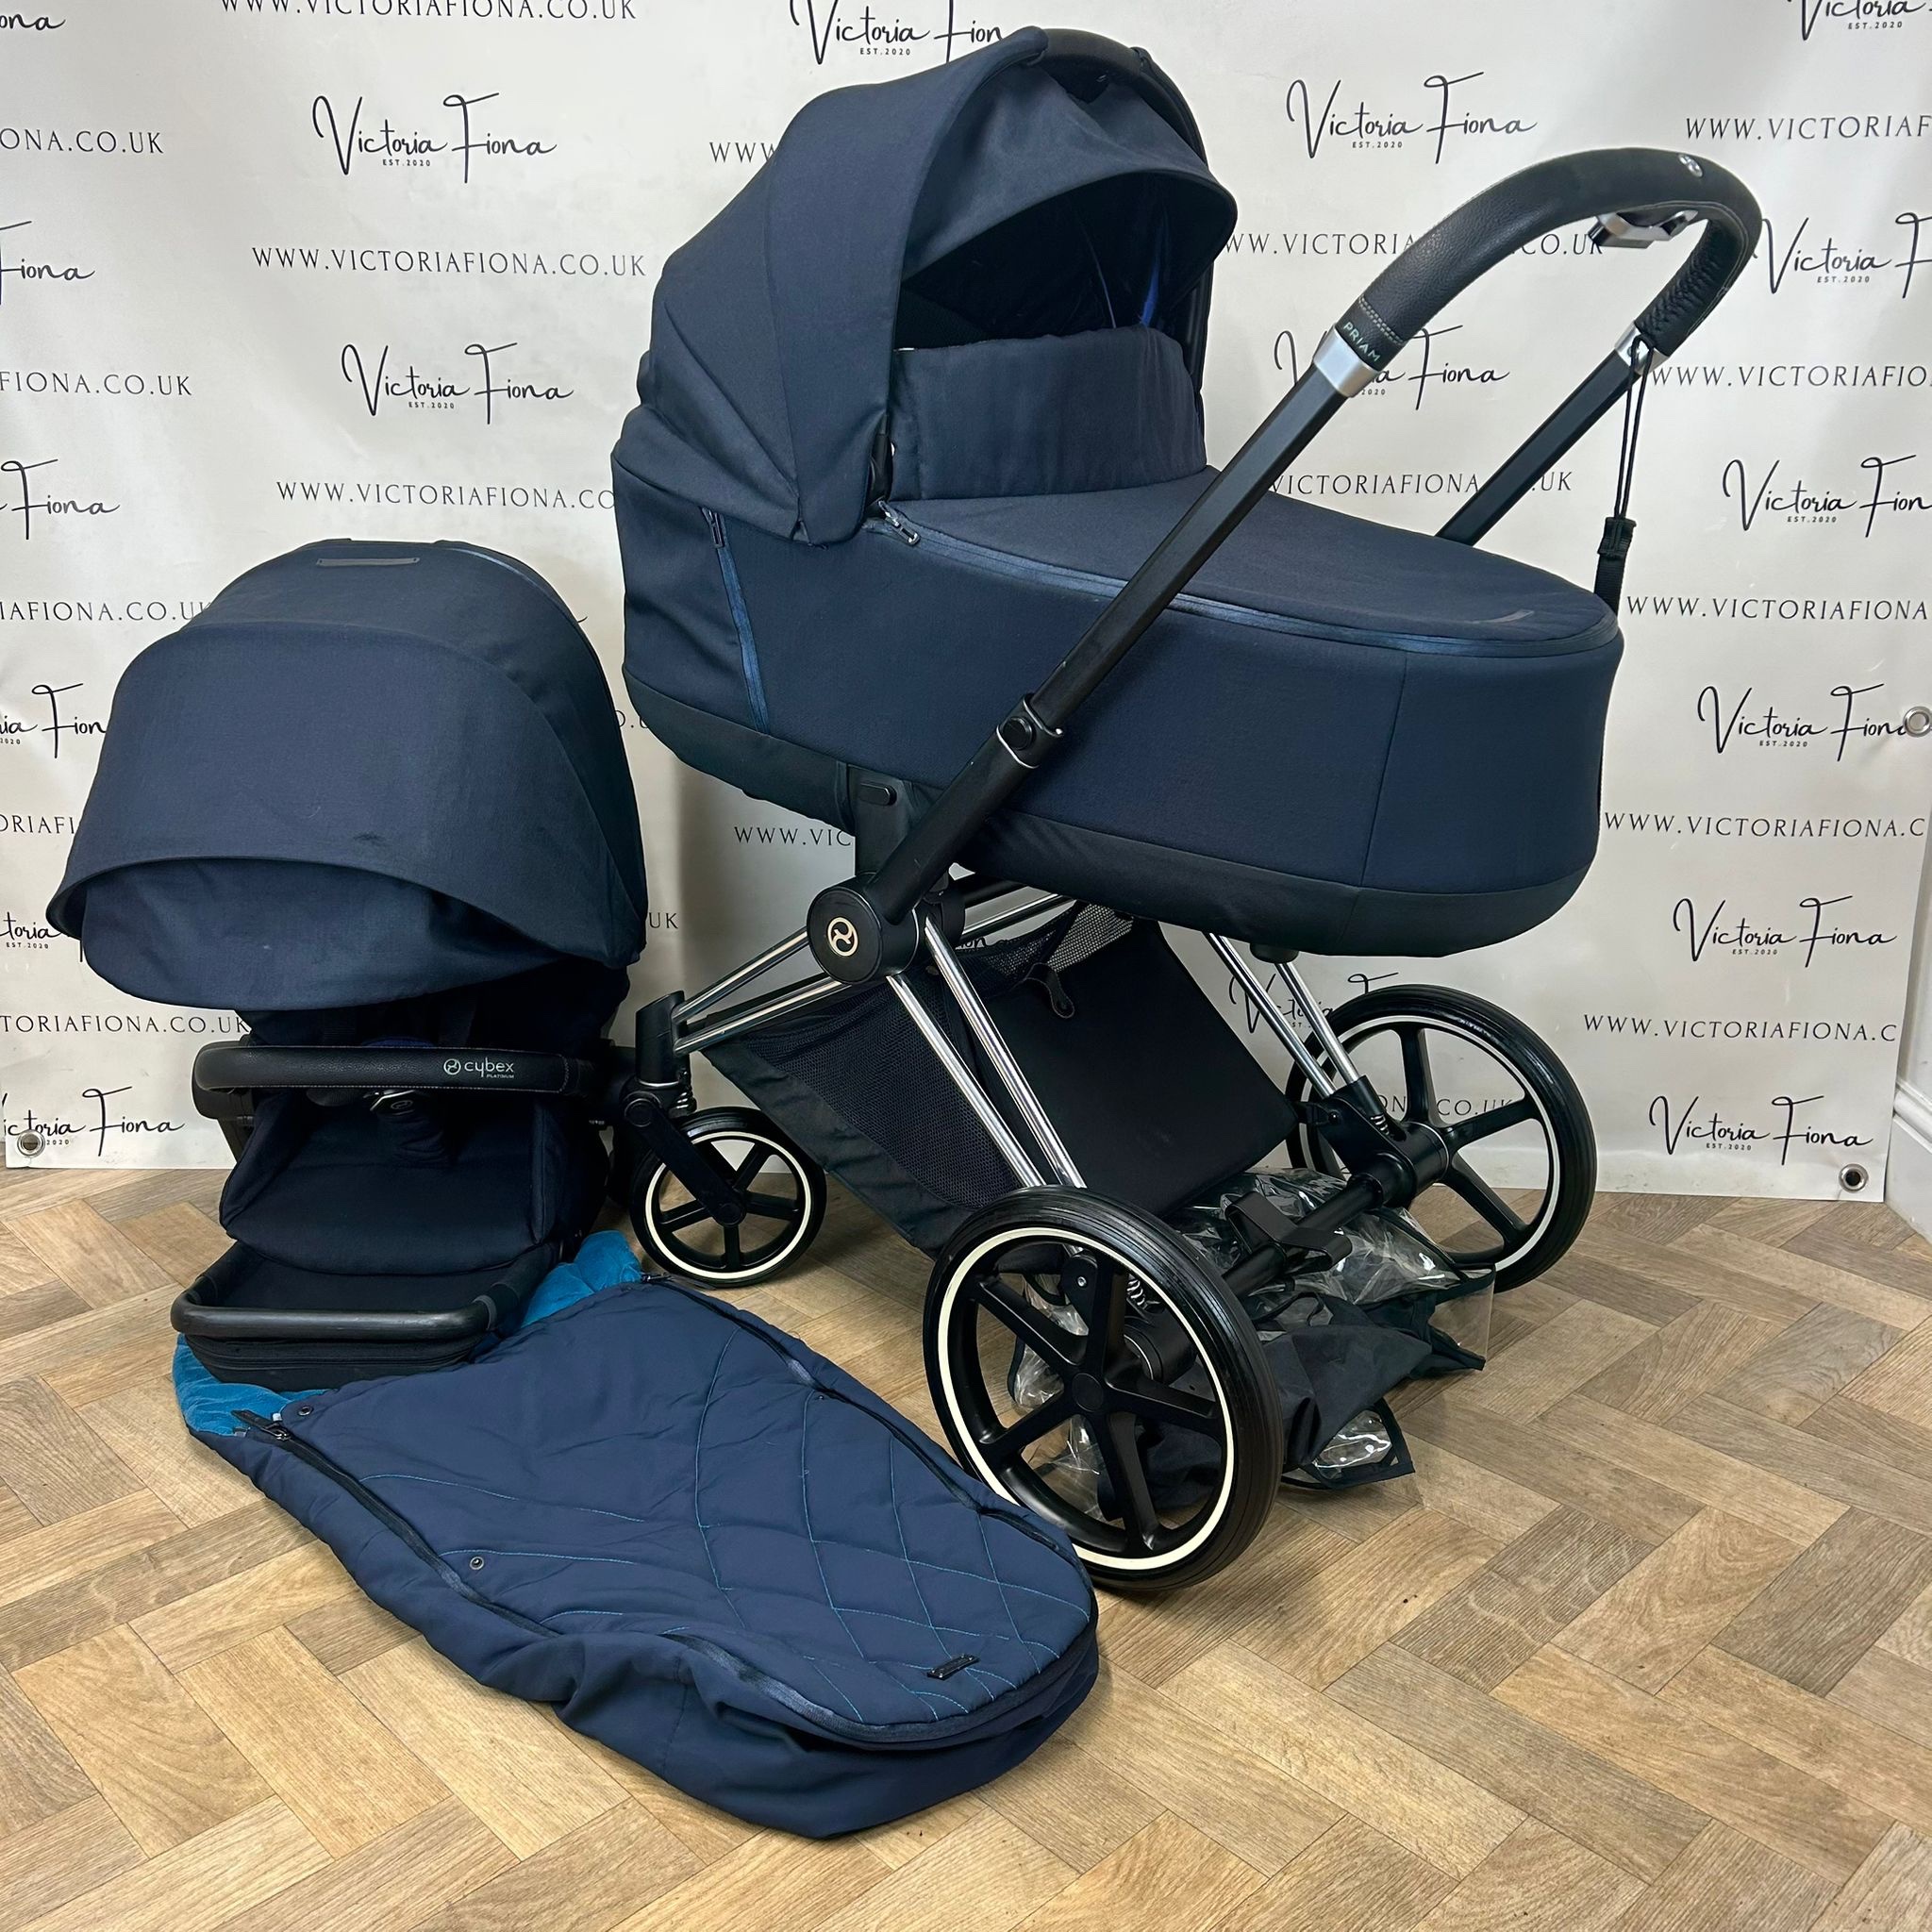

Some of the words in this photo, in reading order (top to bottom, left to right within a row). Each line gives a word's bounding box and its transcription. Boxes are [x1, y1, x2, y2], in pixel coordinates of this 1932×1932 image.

[790, 0, 930, 65] Victoria
[933, 0, 1004, 64] Fion
[1848, 21, 1903, 29] EST.2020
[859, 47, 911, 56] EST.2020
[1286, 79, 1424, 158] Victoria
[1423, 72, 1538, 164] Fiona
[1686, 114, 1932, 141] WWW.VICTORIAF
[312, 95, 448, 175] Victoria
[442, 92, 557, 183] Fiona
[1352, 141, 1404, 149] EST.2020
[382, 158, 431, 167] EST.2020
[252, 247, 646, 277] WWW.VICTORIAFIONA.CO.UK
[1753, 217, 1892, 294] Victoria
[1817, 275, 1870, 284] EST.2020
[1342, 321, 1381, 363] PRIAM
[1408, 325, 1510, 410] Fiona
[1652, 365, 1932, 388] WWW.VICTORIAFIO
[341, 344, 470, 416] Victoria
[464, 342, 574, 425] Fiona
[408, 401, 455, 409] EST.2020
[1, 458, 120, 541] Fiona
[276, 481, 614, 509] WWW.VICTORIAFIONA.CO
[1723, 458, 1857, 531] Victoria
[1787, 515, 1837, 524] EST.2020
[1626, 595, 1928, 621] WWW.VICTORIAFIONA
[1698, 686, 1828, 754] Victoria
[1759, 740, 1808, 748] EST.2020
[1604, 811, 1926, 838] WWW.VICTORIAFIONA.C
[1673, 897, 1797, 962] Victoria
[1798, 894, 1898, 968] Fiona
[1732, 948, 1778, 957] EST.2020
[1583, 1013, 1898, 1042] WWW.VICTORIAFIONA.C
[464, 1057, 514, 1077] cybex
[82, 1086, 186, 1158] Fiona
[1649, 1095, 1771, 1156] Victoria
[1772, 1094, 1874, 1167] Fiona
[1706, 1141, 1753, 1151] EST.2020
